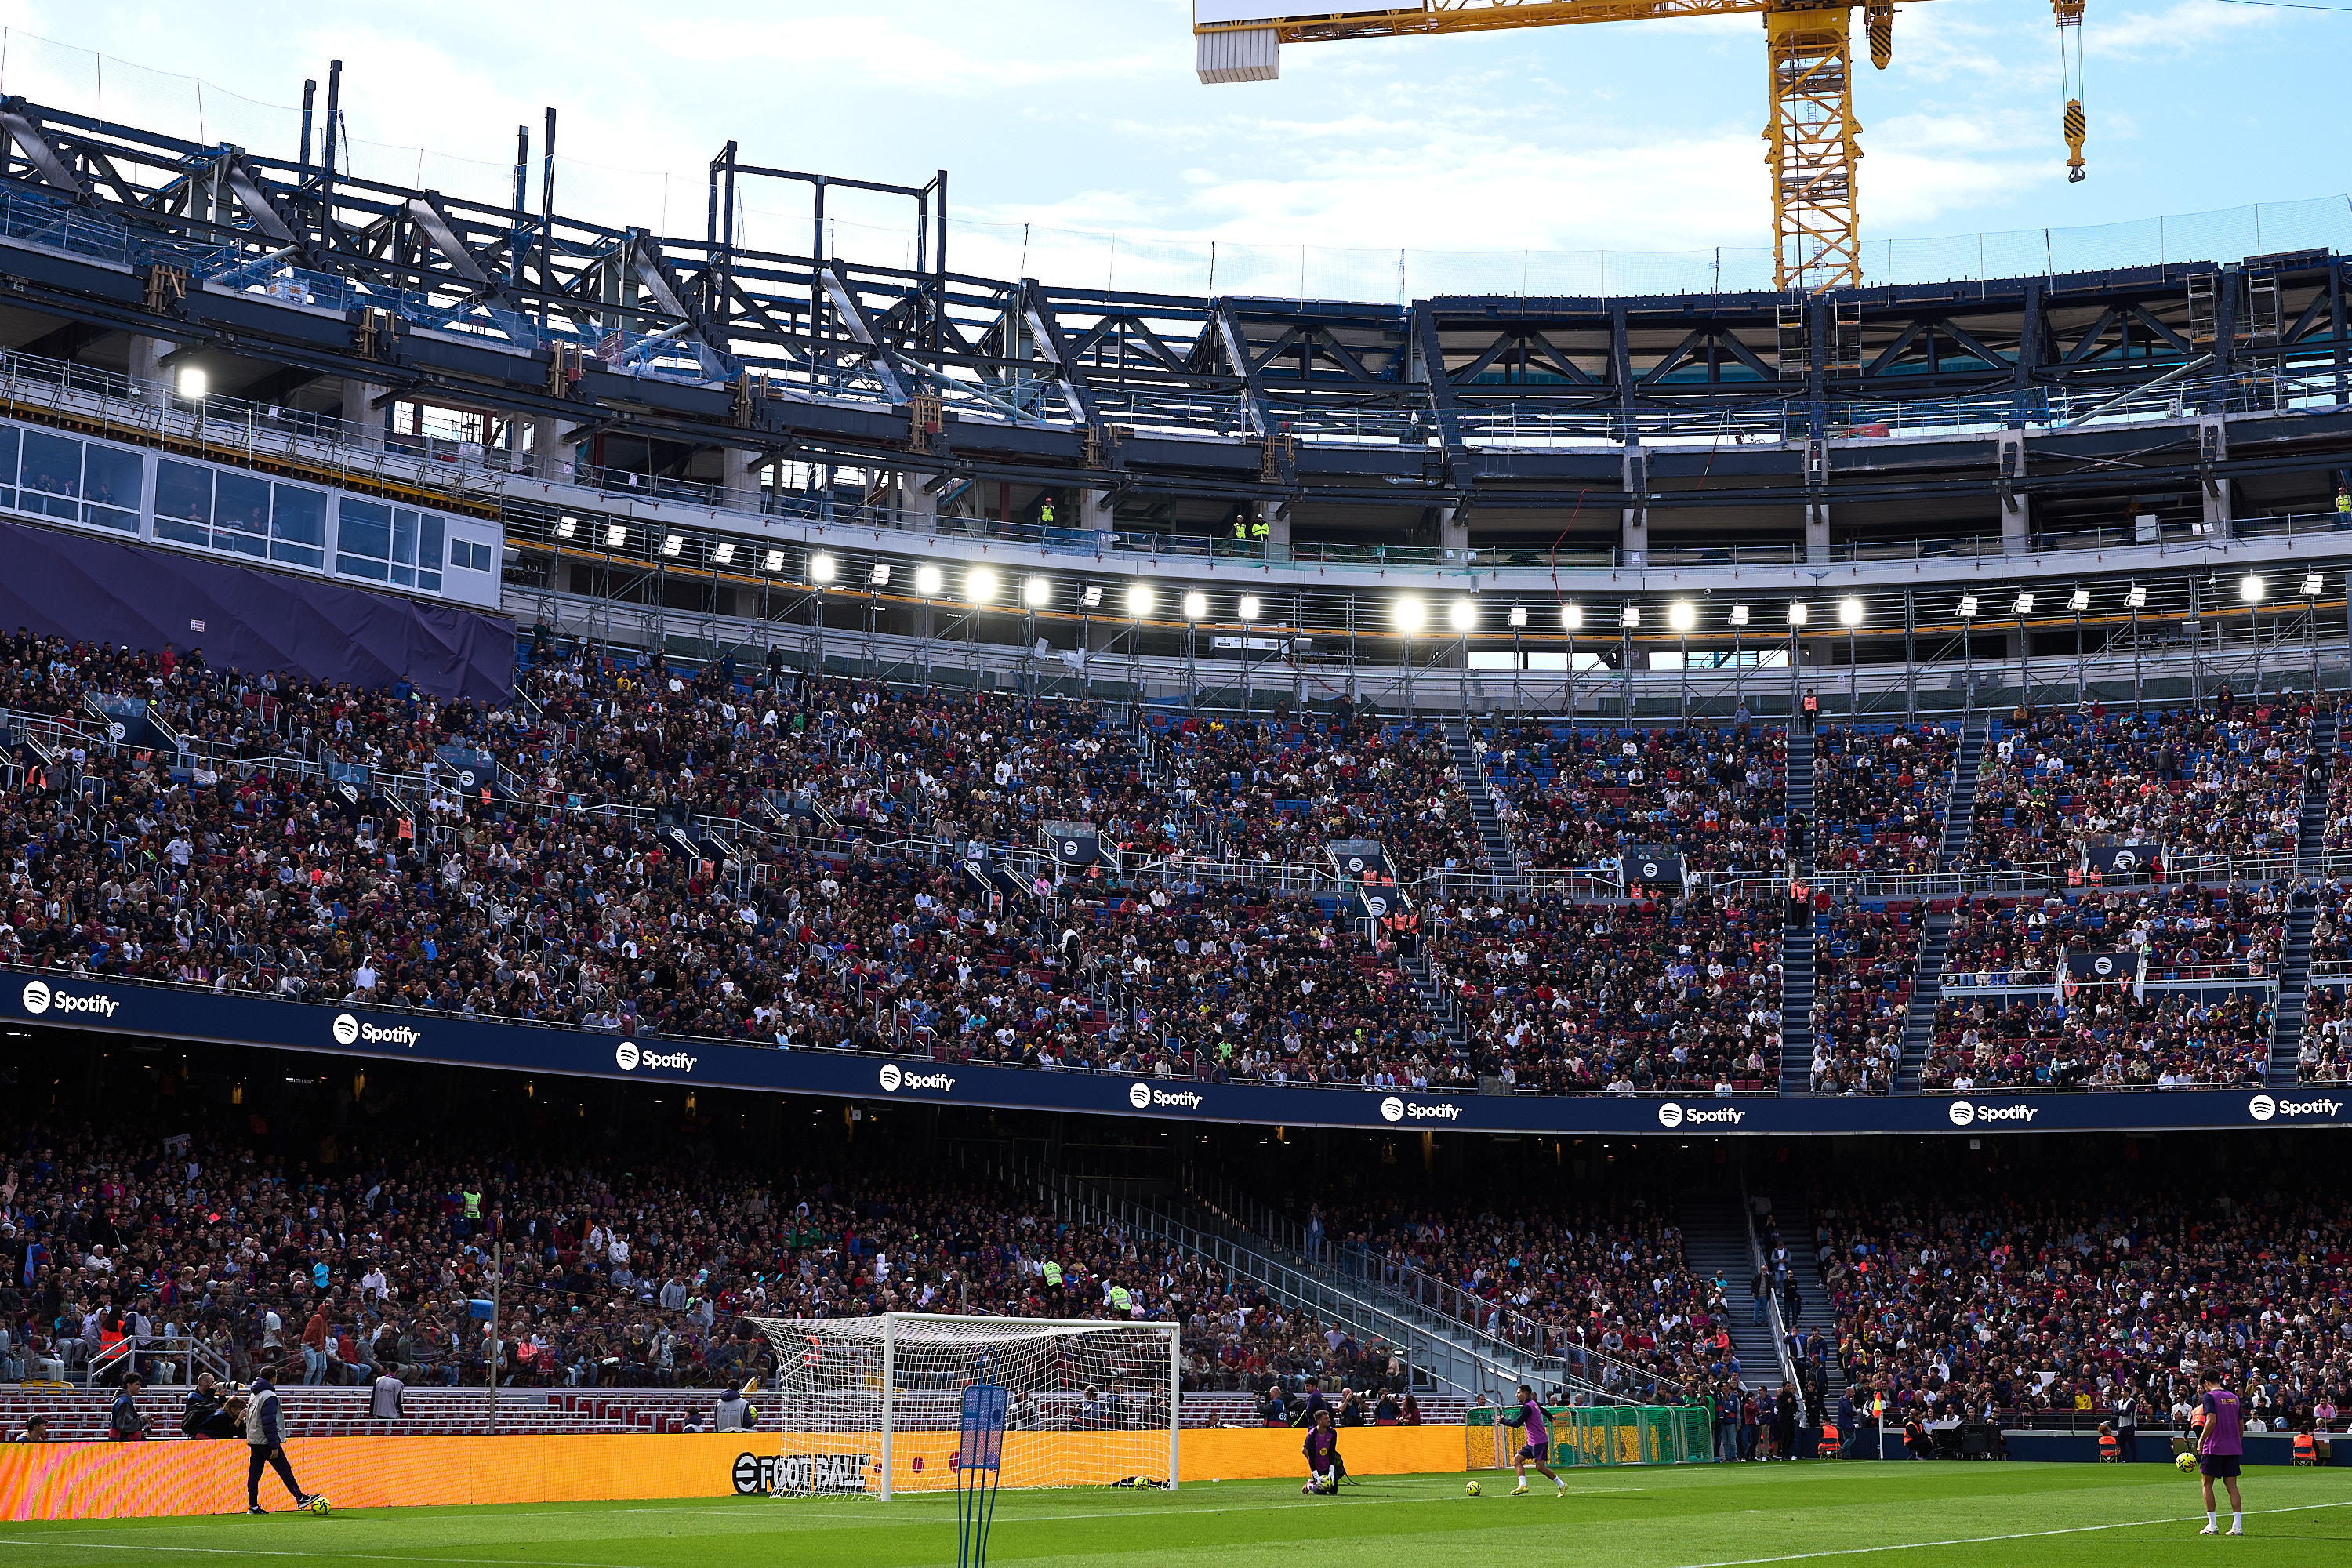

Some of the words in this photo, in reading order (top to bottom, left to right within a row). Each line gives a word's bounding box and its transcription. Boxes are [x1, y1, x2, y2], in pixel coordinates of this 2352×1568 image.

[1908, 866, 1915, 874] 9
[54, 990, 119, 1018] Spotify
[361, 1022, 421, 1047] Spotify
[642, 1049, 697, 1073] Spotify
[904, 1071, 956, 1092] Spotify
[1153, 1089, 1203, 1109] Spotify
[2279, 1098, 2343, 1117] Spotify
[1406, 1102, 1462, 1121] Spotify
[1686, 1107, 1746, 1125] Spotify
[1977, 1104, 2038, 1123] Spotify
